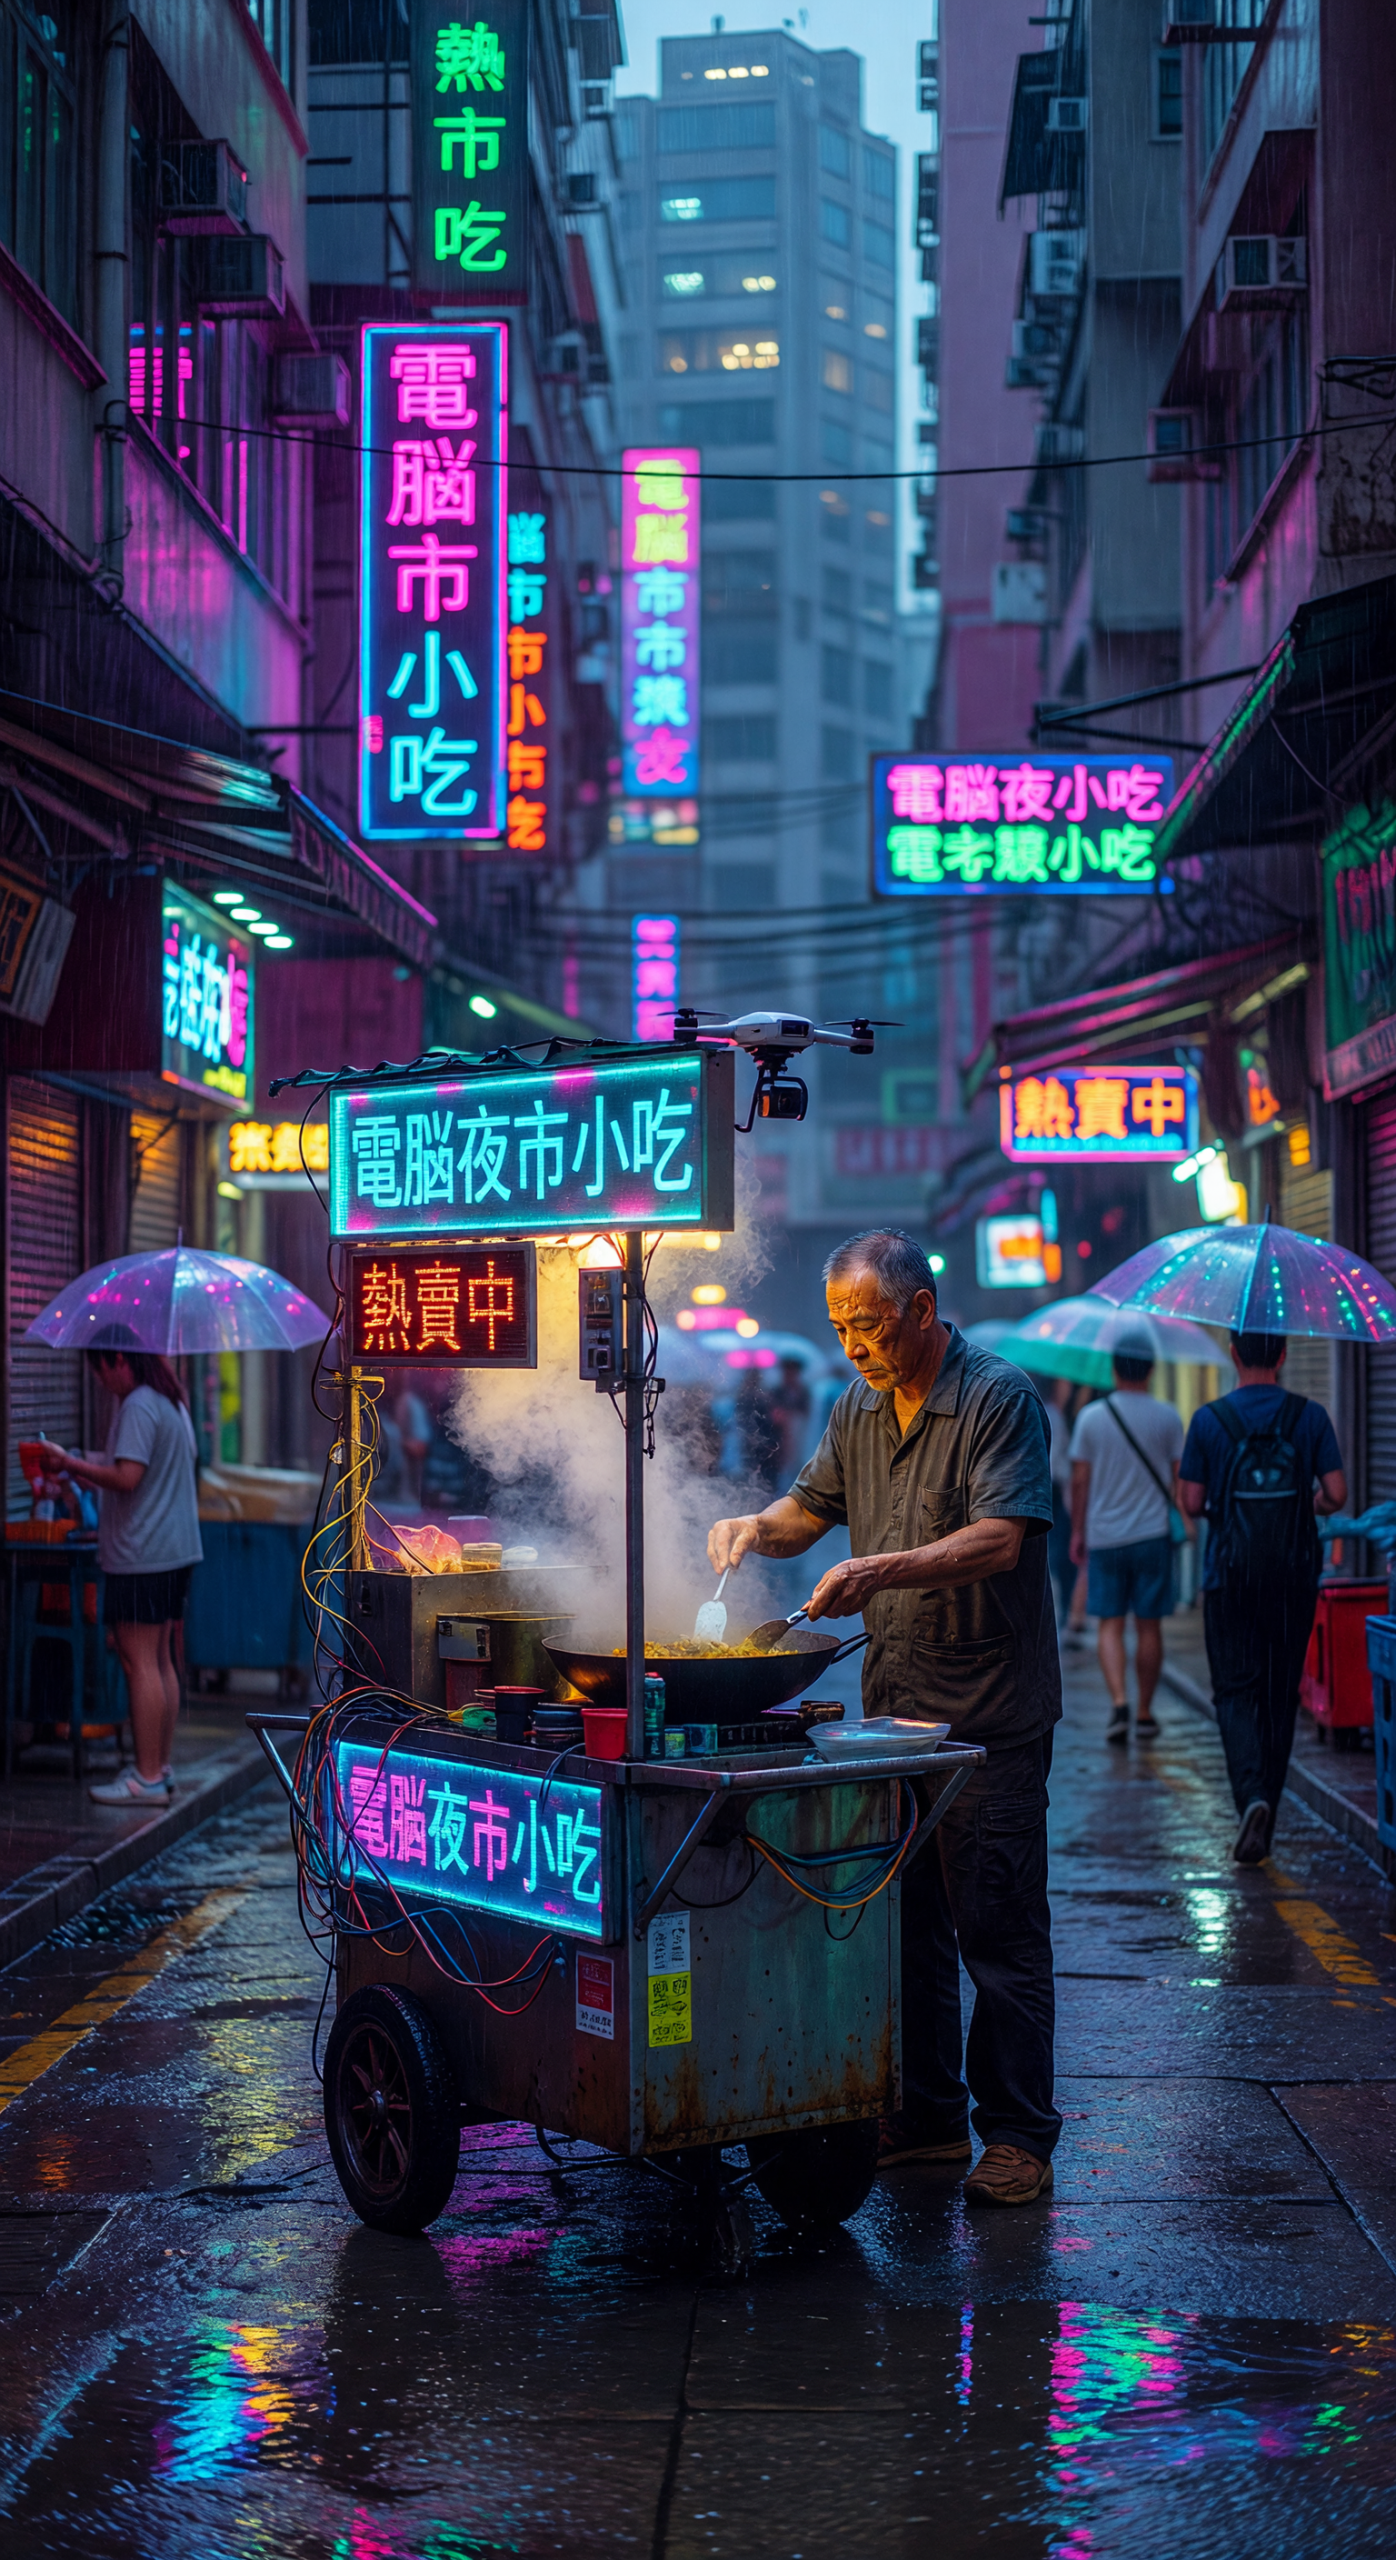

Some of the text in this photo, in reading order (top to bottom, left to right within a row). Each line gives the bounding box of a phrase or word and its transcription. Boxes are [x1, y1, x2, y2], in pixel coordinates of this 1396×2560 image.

[433, 22, 507, 272] 熱市吃
[362, 1260, 514, 1351] 熱賣中
